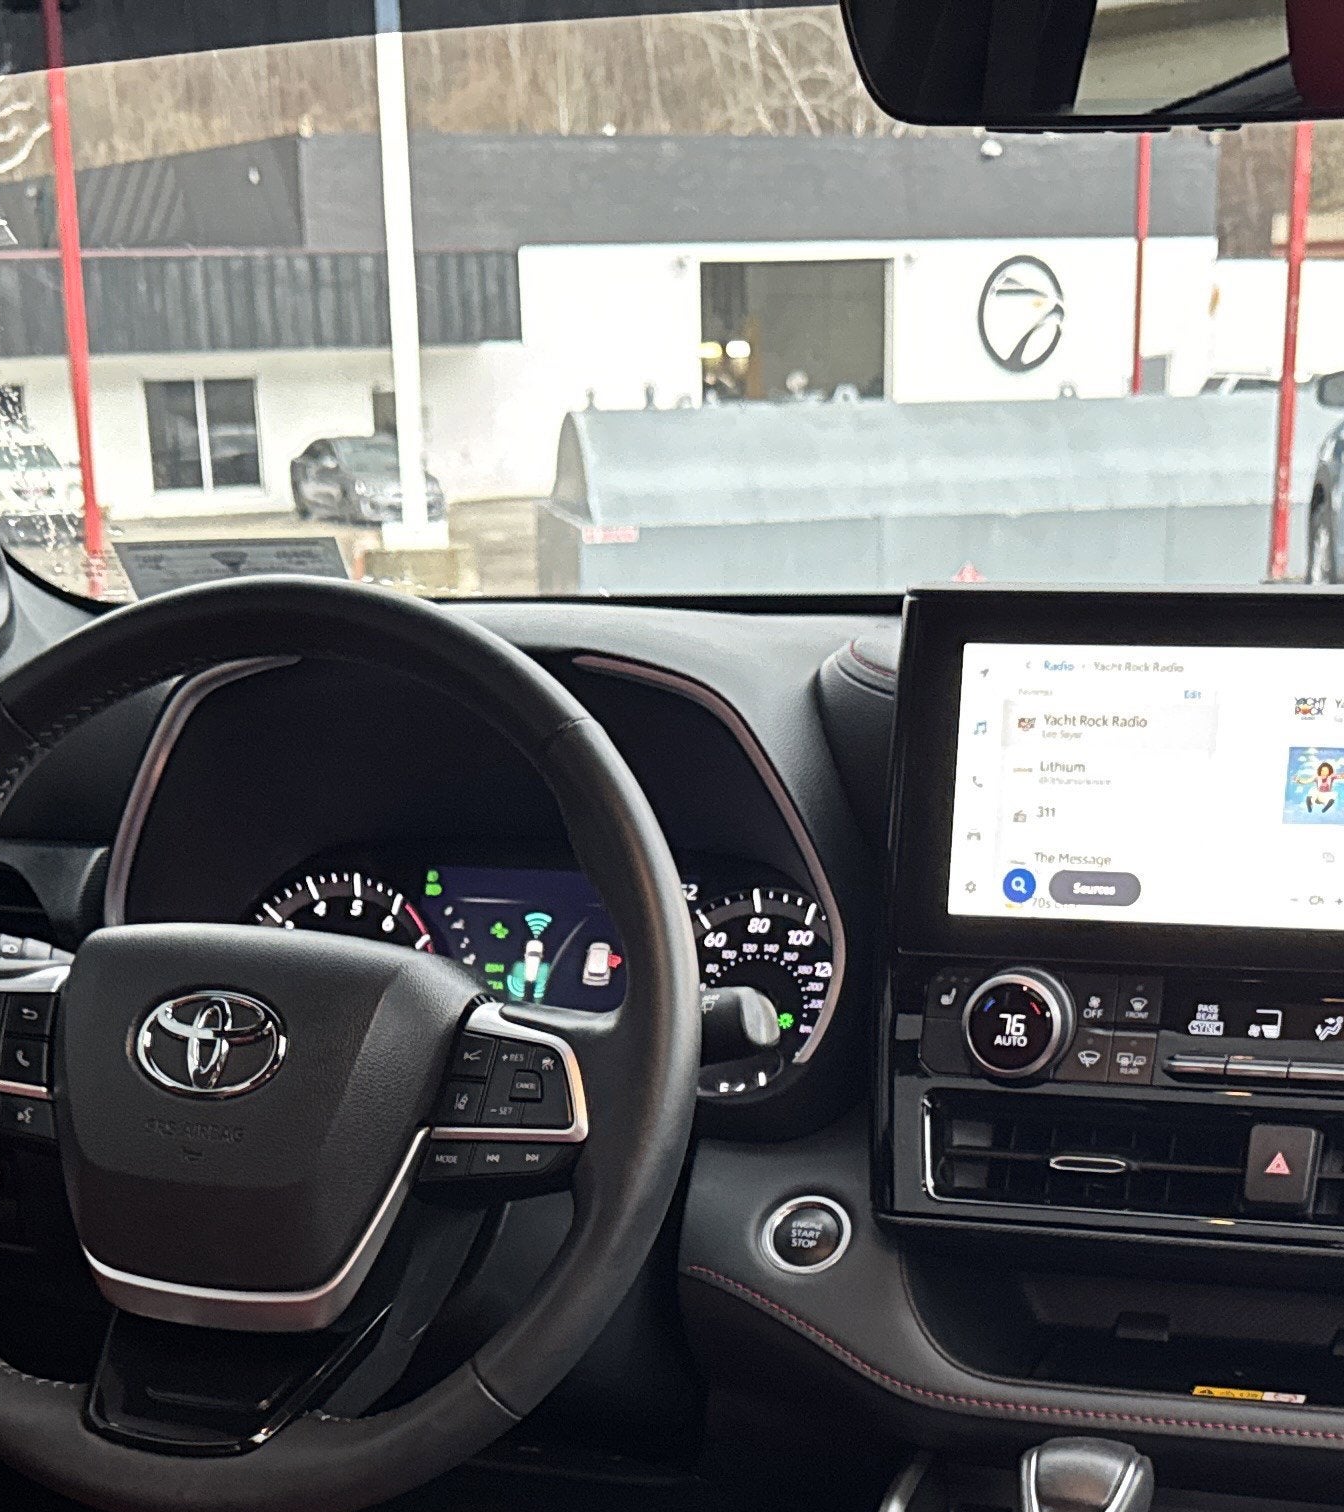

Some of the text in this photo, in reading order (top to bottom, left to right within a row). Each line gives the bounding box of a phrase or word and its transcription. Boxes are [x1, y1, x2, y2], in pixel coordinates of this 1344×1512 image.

[1044, 661, 1074, 672] Radio
[1124, 662, 1150, 673] Rock
[1044, 714, 1148, 728] Yacht Rock Radio
[1040, 761, 1086, 773] Lithium
[1036, 806, 1056, 818] 311
[1034, 852, 1112, 867] The Message
[1072, 882, 1116, 896] Sources
[313, 900, 327, 917] 4
[349, 899, 364, 916] 5
[381, 915, 395, 932] 6
[747, 917, 771, 934] 80
[703, 932, 728, 948] 60
[787, 929, 814, 946] 100
[1083, 1008, 1104, 1020] OFF
[1125, 1011, 1149, 1020] FRONT
[999, 1013, 1027, 1037] 76
[994, 1035, 1028, 1048] AUTO
[435, 1154, 458, 1164] MODE
[790, 1228, 821, 1239] START
[790, 1238, 817, 1249] STOP
